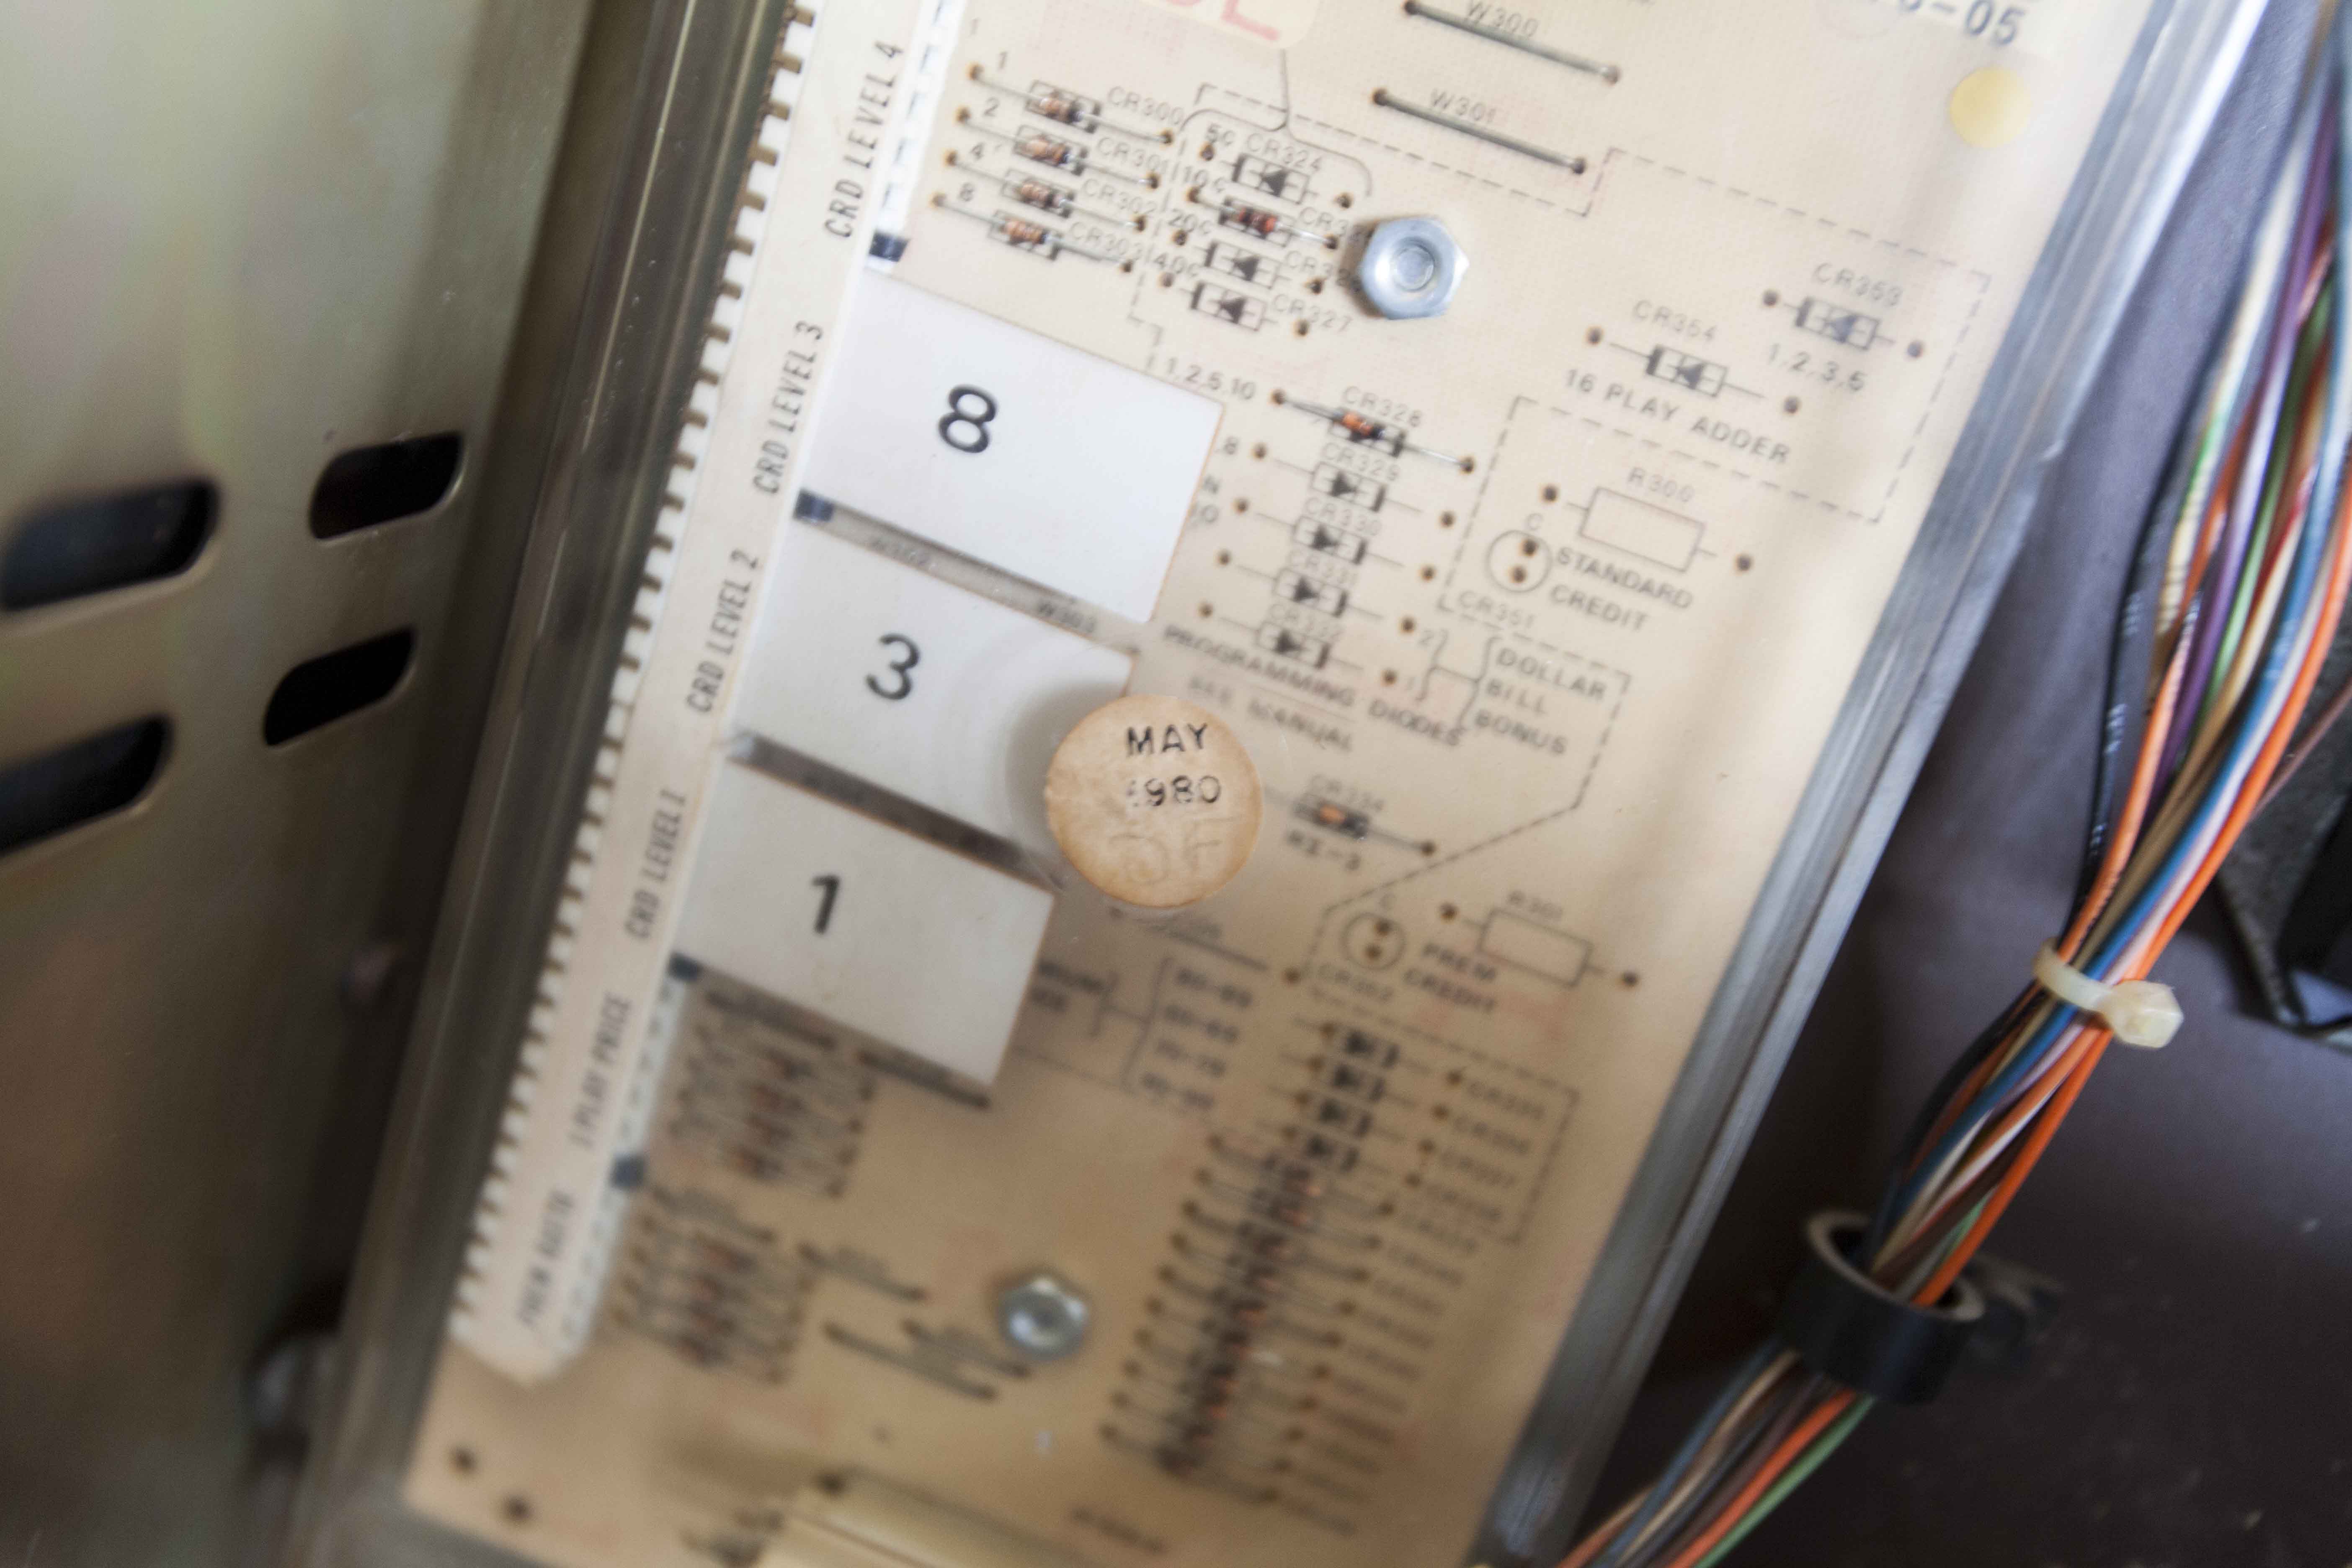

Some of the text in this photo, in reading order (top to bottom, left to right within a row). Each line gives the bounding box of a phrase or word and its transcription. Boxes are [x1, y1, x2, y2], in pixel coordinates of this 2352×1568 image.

[984, 97, 1000, 117] 2
[1107, 85, 1184, 126] CR300
[823, 41, 903, 239] CRD LEVEL 4
[970, 142, 985, 160] 4
[959, 182, 975, 202] 8
[752, 320, 823, 495] CRD LEVEL 3
[937, 383, 999, 455] 8
[1564, 367, 1792, 464] 16 PLAY ADDER
[1557, 546, 1695, 611] STANDARD
[685, 548, 759, 714] CRD LEVEL 2
[1549, 583, 1648, 632] CREDIT
[864, 632, 921, 701] 3
[1496, 647, 1608, 701] DOLLAR
[1485, 678, 1547, 715] BILL
[1124, 722, 1208, 756] MAY
[1474, 709, 1568, 755] BONUS
[811, 874, 841, 936] 1
